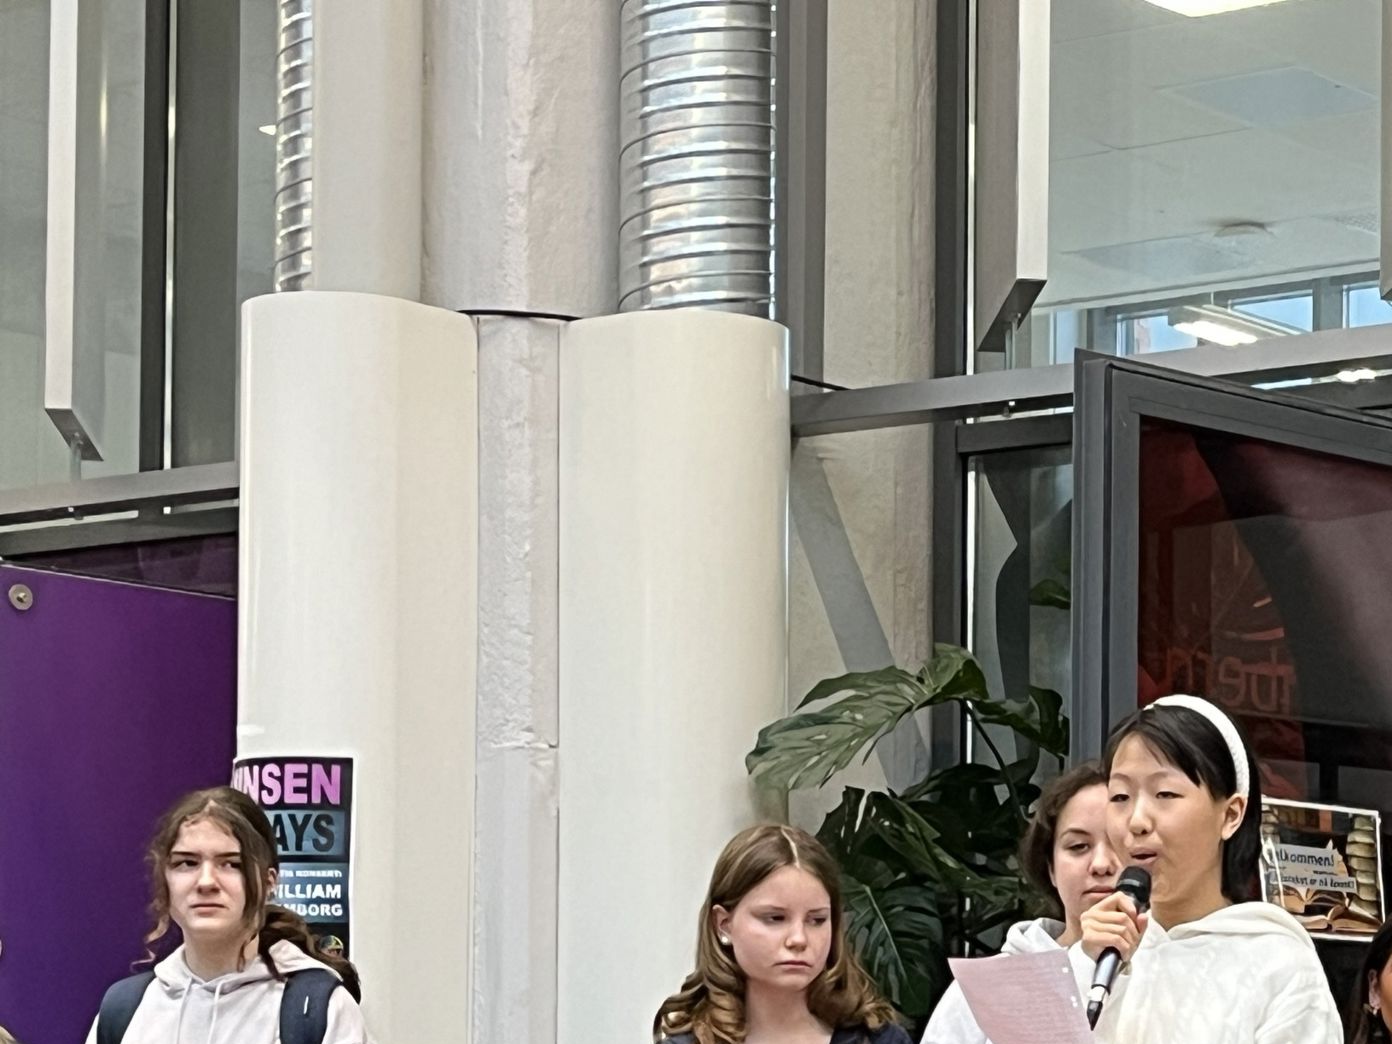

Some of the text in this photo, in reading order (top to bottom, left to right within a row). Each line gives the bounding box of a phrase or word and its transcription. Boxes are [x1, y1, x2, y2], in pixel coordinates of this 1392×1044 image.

[1268, 847, 1335, 867] lkommen!
[274, 883, 341, 899] ILLIAM
[276, 903, 343, 917] BORG
